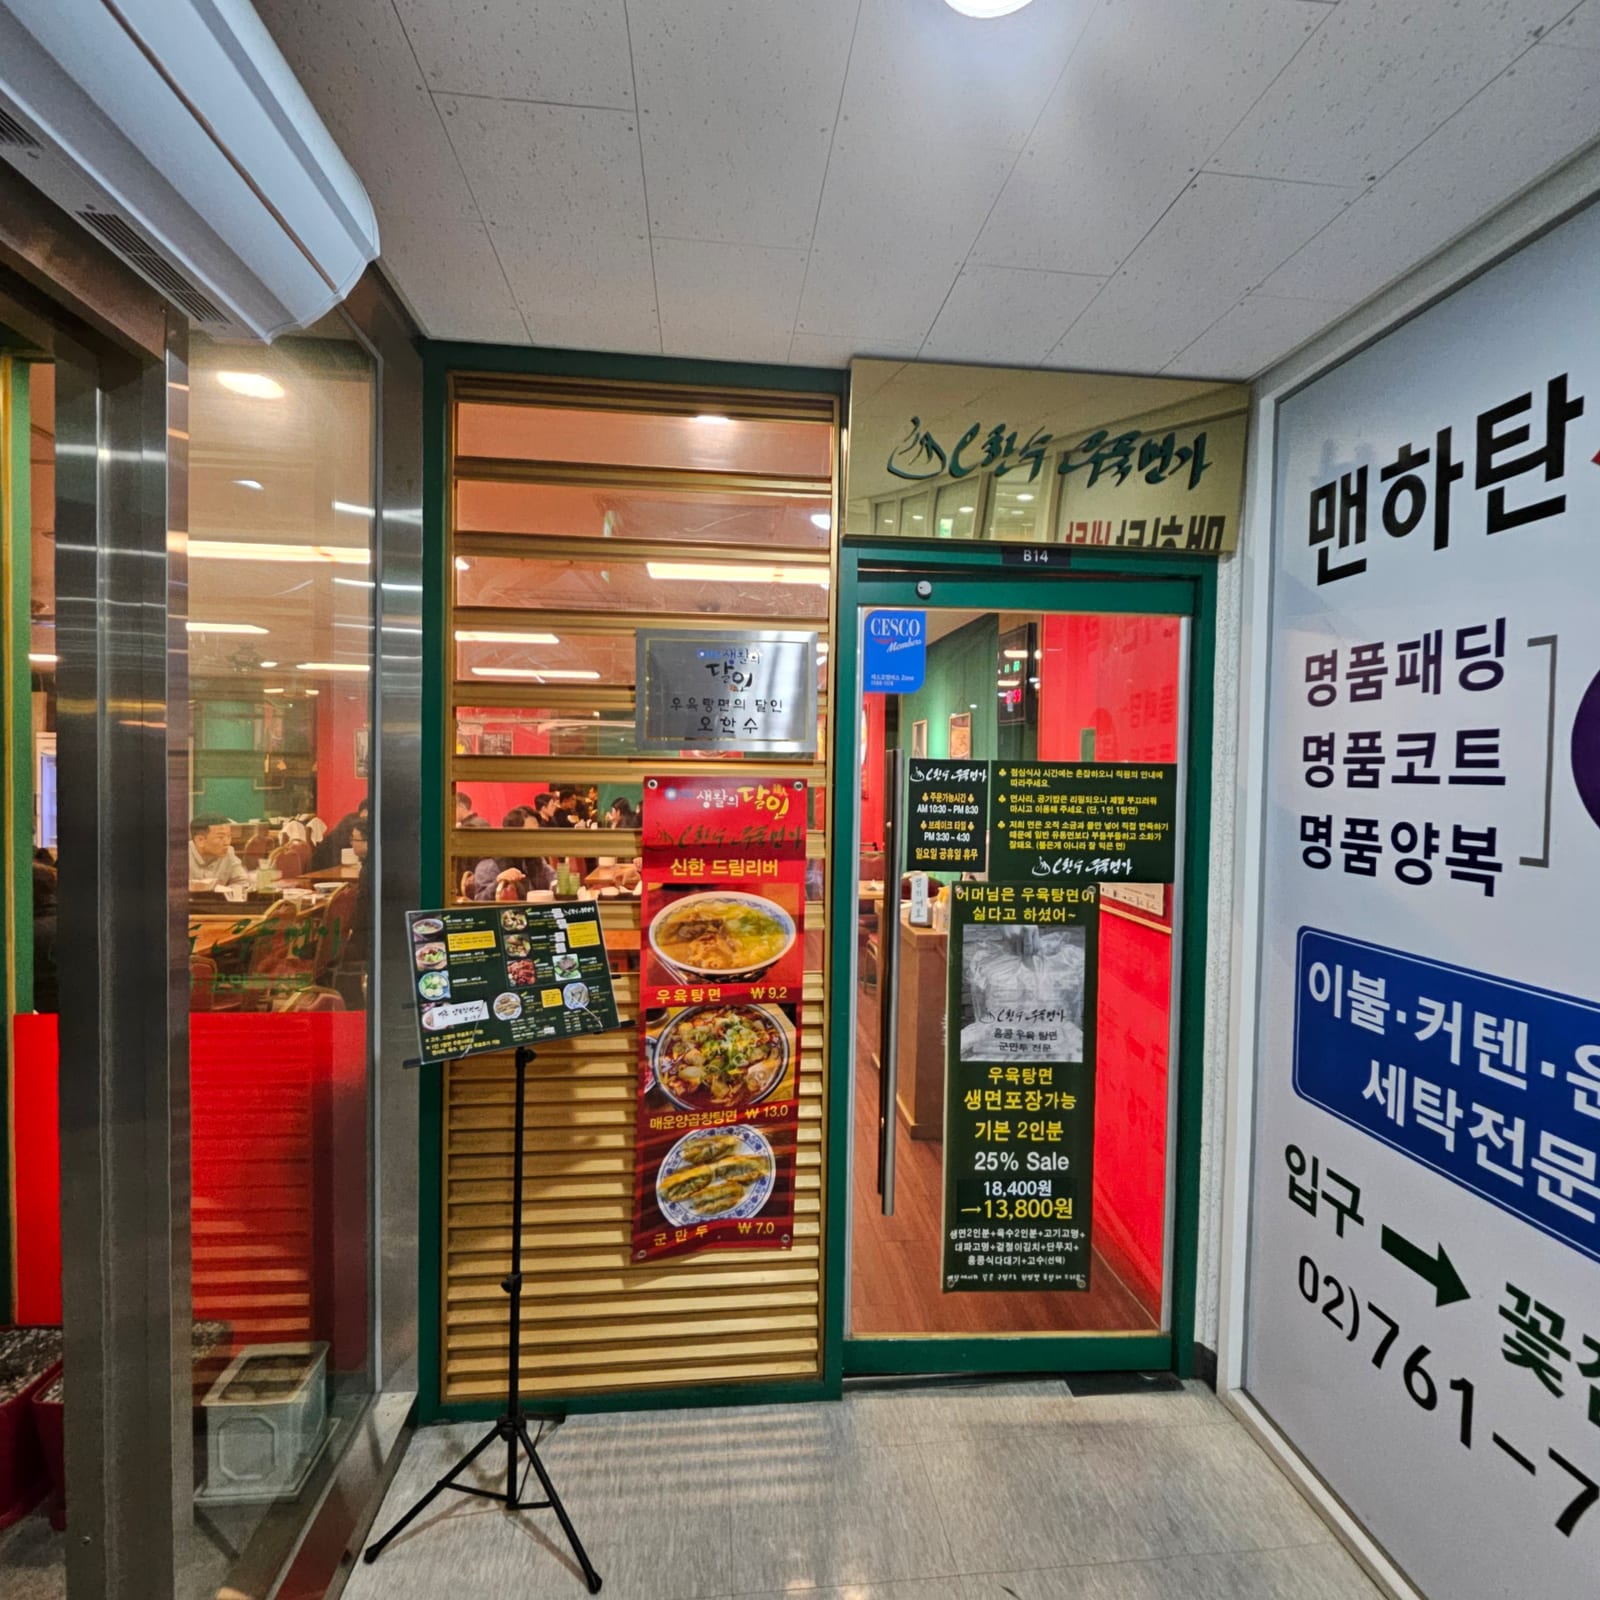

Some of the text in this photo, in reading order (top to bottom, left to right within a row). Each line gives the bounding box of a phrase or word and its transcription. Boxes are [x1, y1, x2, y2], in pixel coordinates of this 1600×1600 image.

[1057, 429, 1213, 490] 우육면가
[1309, 372, 1585, 586] 맨하탄
[1023, 549, 1049, 563] B14
[871, 617, 920, 637] CESCO
[887, 637, 922, 653] Members
[723, 647, 760, 665] 생활의
[1304, 617, 1507, 707] 명품패딩
[705, 661, 753, 692] 달인
[669, 696, 783, 714] 우육탕면의 달인
[697, 715, 759, 734] 오한수
[1302, 728, 1507, 789] 명품코트
[1043, 768, 1074, 778] 시간에는
[696, 788, 739, 809] 생활의
[736, 783, 790, 821] 달인
[1037, 794, 1068, 804] 공기밥은
[917, 804, 928, 813] AM
[929, 804, 946, 813] 10:30
[953, 805, 964, 814] PM
[965, 805, 979, 814] 8:30
[1010, 804, 1033, 813] 마시고
[928, 820, 966, 831] 브레이크 타임
[1009, 820, 1025, 829] 저희
[1027, 820, 1042, 830] 면은
[1044, 821, 1060, 830] 오직
[924, 832, 935, 841] PM
[936, 832, 949, 841] 3:30
[956, 832, 970, 842] 4:30
[1035, 830, 1050, 840] 일반
[915, 848, 978, 861] 일요일 공휴일 휴무
[1064, 841, 1086, 850] 아니라
[1300, 814, 1503, 897] 명품양복
[670, 858, 779, 877] 신한 드림리버
[956, 887, 1015, 902] 어머님은
[1021, 886, 1095, 903] 우육탕면이
[972, 907, 1017, 922] 싫다고
[656, 987, 721, 1004] 우육탕면
[768, 986, 788, 999] 9.2
[999, 1041, 1028, 1053] 군만두
[988, 1067, 1053, 1086] 우육탕면
[964, 1089, 1077, 1111] 생면포장가능
[649, 1108, 738, 1130] 매운양곱창탕면
[764, 1104, 788, 1117] 13.0
[975, 1120, 1064, 1142] 기본 2인분
[1361, 1058, 1600, 1225] 세탁전문
[974, 1151, 1070, 1171] 25% Sale
[983, 1180, 1052, 1198] 18,400원
[1284, 1143, 1365, 1239] 입구
[755, 1221, 775, 1235] 7.0
[1498, 1281, 1600, 1428] 꽃
[1298, 1254, 1600, 1539] 02)761-7
